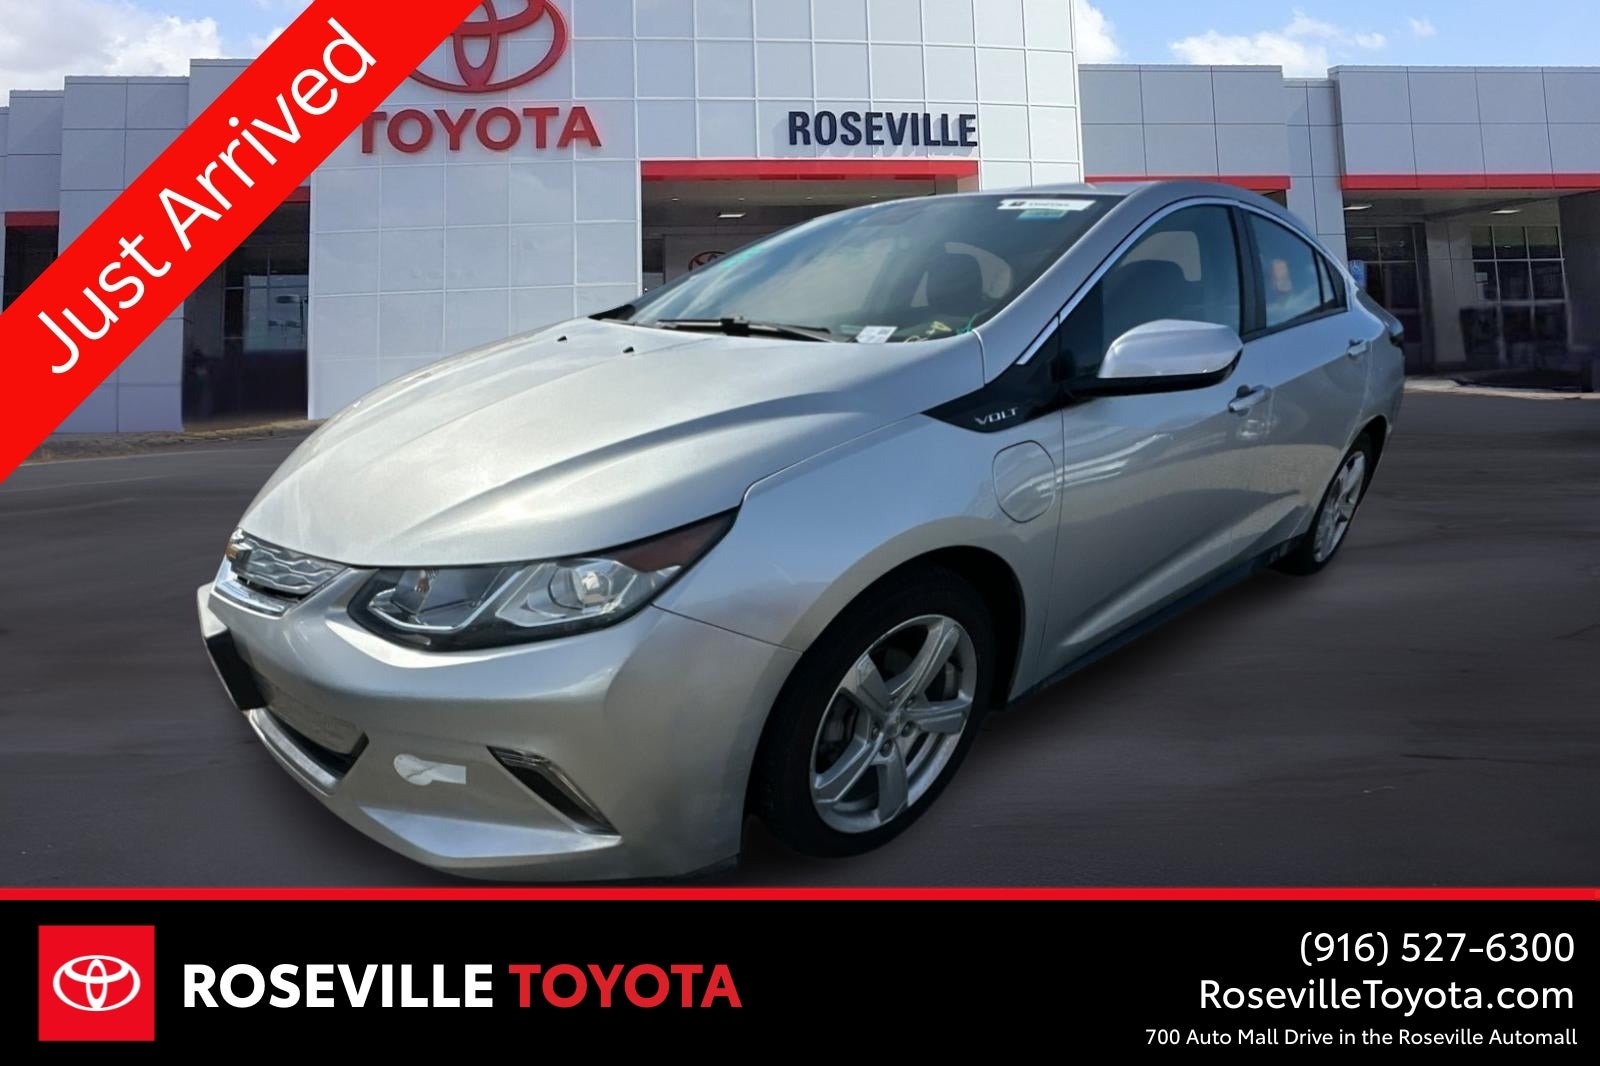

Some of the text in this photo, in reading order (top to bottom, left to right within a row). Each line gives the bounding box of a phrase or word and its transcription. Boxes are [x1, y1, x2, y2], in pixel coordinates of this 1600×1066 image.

[361, 106, 602, 154] TOYOTA
[788, 110, 978, 147] ROSEVILLE
[974, 407, 1019, 425] VOLT
